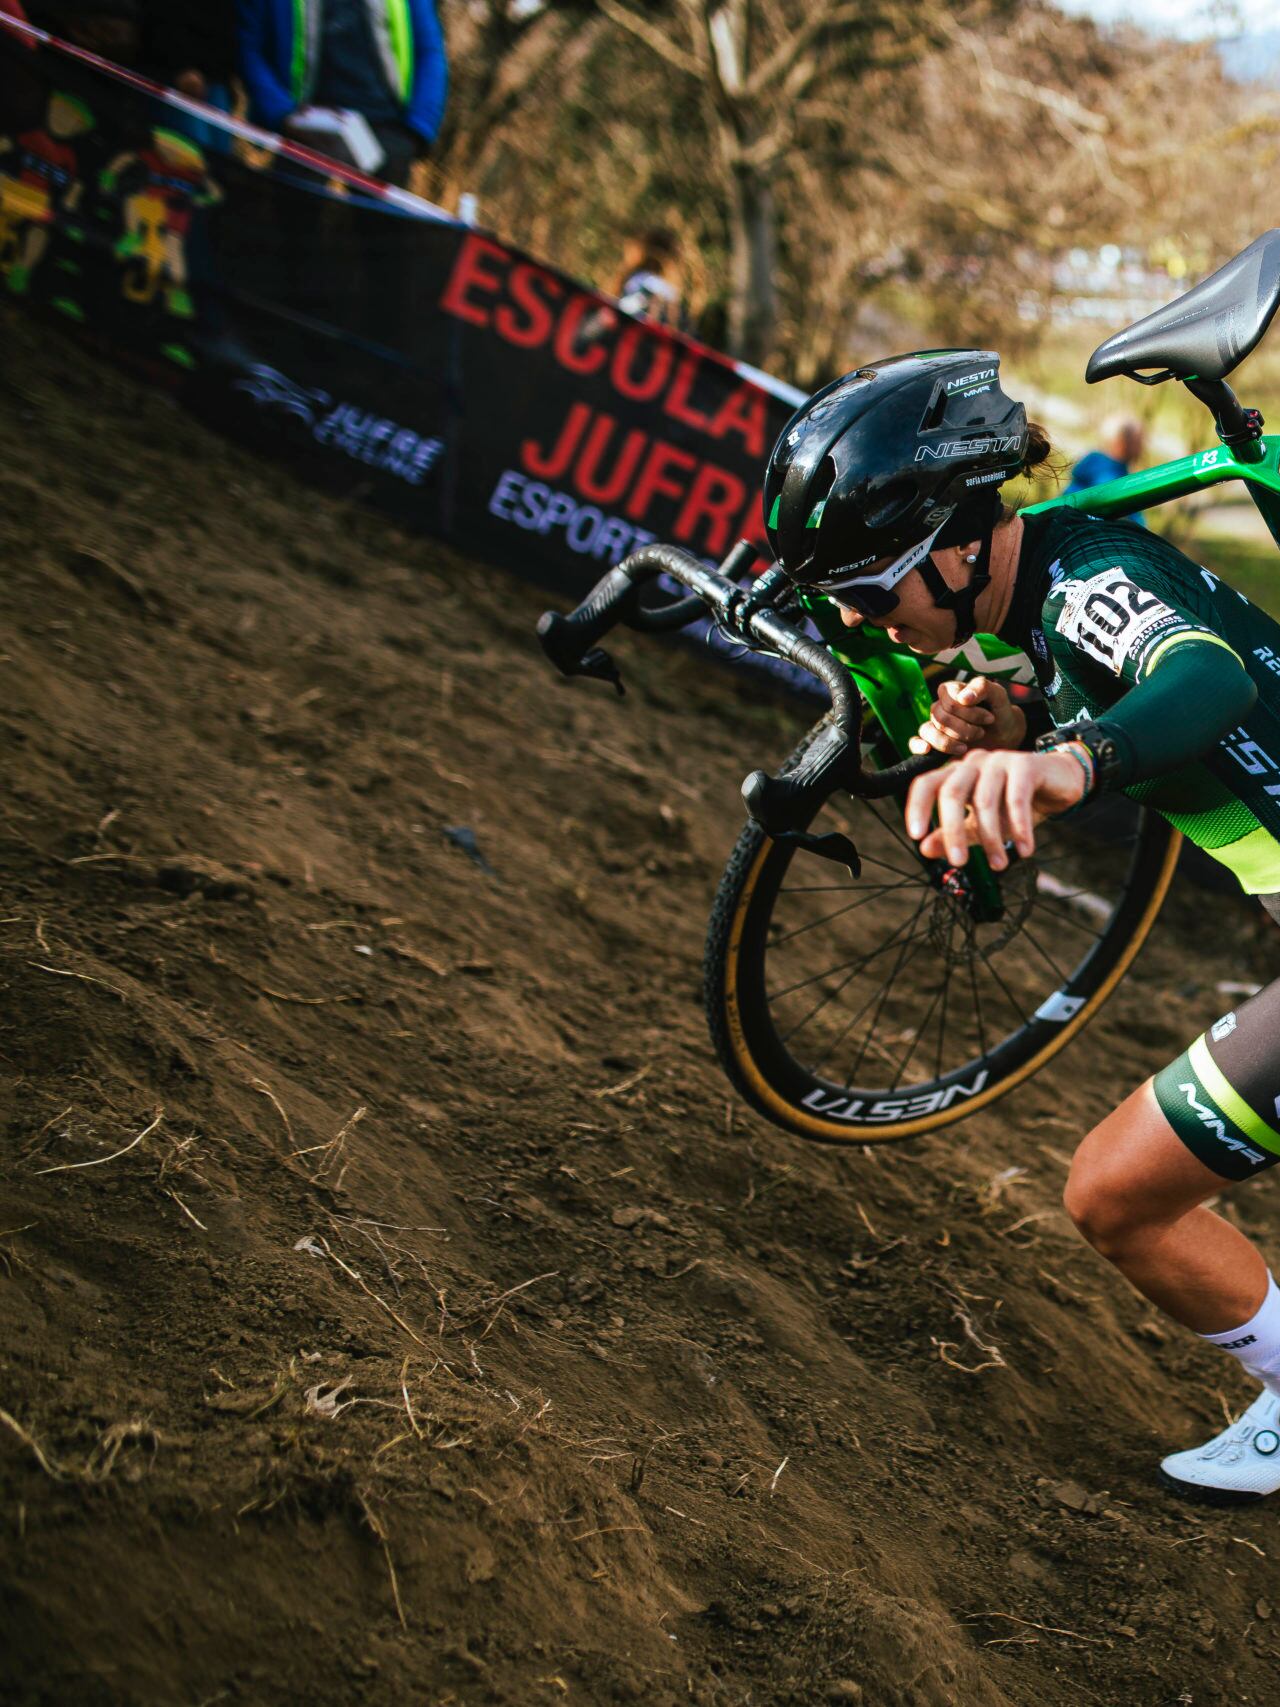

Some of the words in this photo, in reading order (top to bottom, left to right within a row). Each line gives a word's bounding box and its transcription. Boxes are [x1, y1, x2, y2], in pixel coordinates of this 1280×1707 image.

[440, 231, 770, 459] ESCOLA
[947, 368, 995, 390] NESTA
[963, 384, 992, 399] MMR
[914, 435, 1021, 462] NESTA
[828, 555, 877, 575] NESTA
[892, 545, 924, 578] NESTA
[1076, 581, 1162, 661] 102
[801, 1069, 990, 1122] NESTA
[1178, 1082, 1266, 1166] MMR
